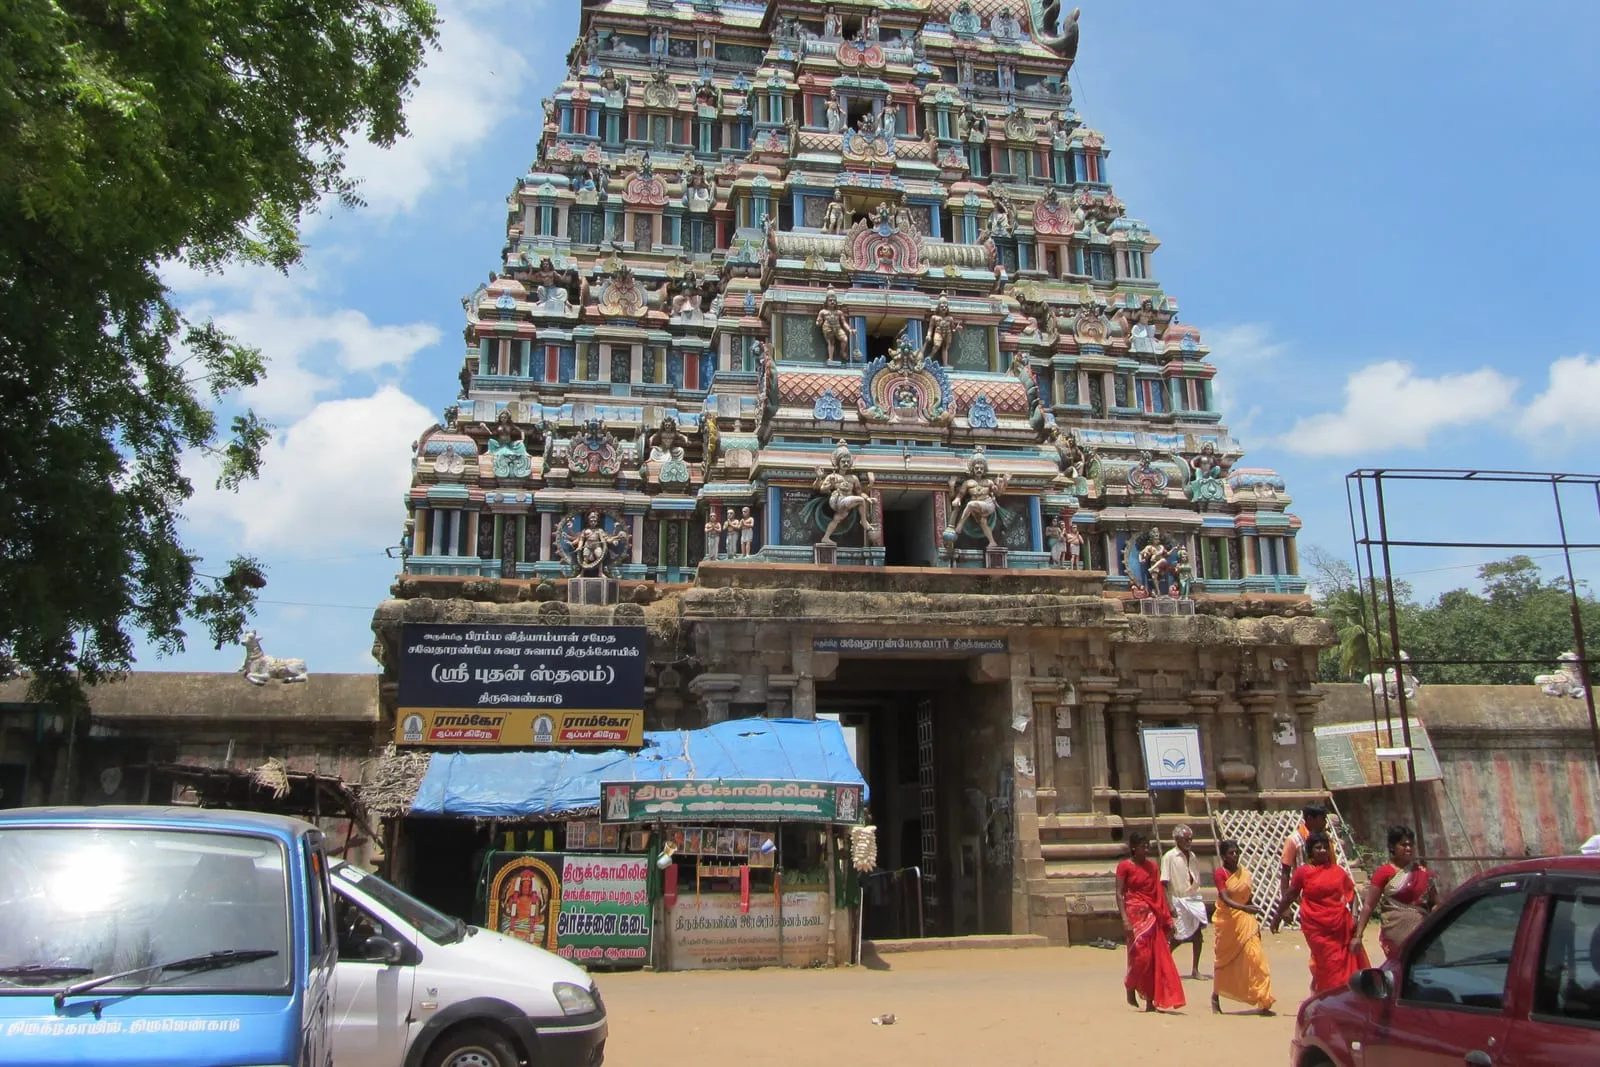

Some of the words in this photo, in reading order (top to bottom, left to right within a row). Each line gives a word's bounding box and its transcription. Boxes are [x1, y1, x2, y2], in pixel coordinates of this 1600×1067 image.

[465, 630, 503, 642] பிரம்ம
[582, 633, 617, 644] சமேத
[524, 646, 563, 656] சுவாமி
[565, 646, 639, 658] திருக்கோயில்
[431, 663, 470, 683] (ஸ்ரீ
[474, 664, 526, 684] புதன்
[530, 664, 615, 685] ஸ்தலம்)
[478, 692, 563, 704] திருவெண்காடு
[434, 714, 504, 727] ராம்கோ
[563, 715, 631, 728] ராம்கோ
[634, 782, 828, 801] திருக்கோவிலின்
[608, 887, 632, 905] பெற்ற
[557, 905, 618, 936] அர்ச்சனை
[619, 913, 649, 936] கடை
